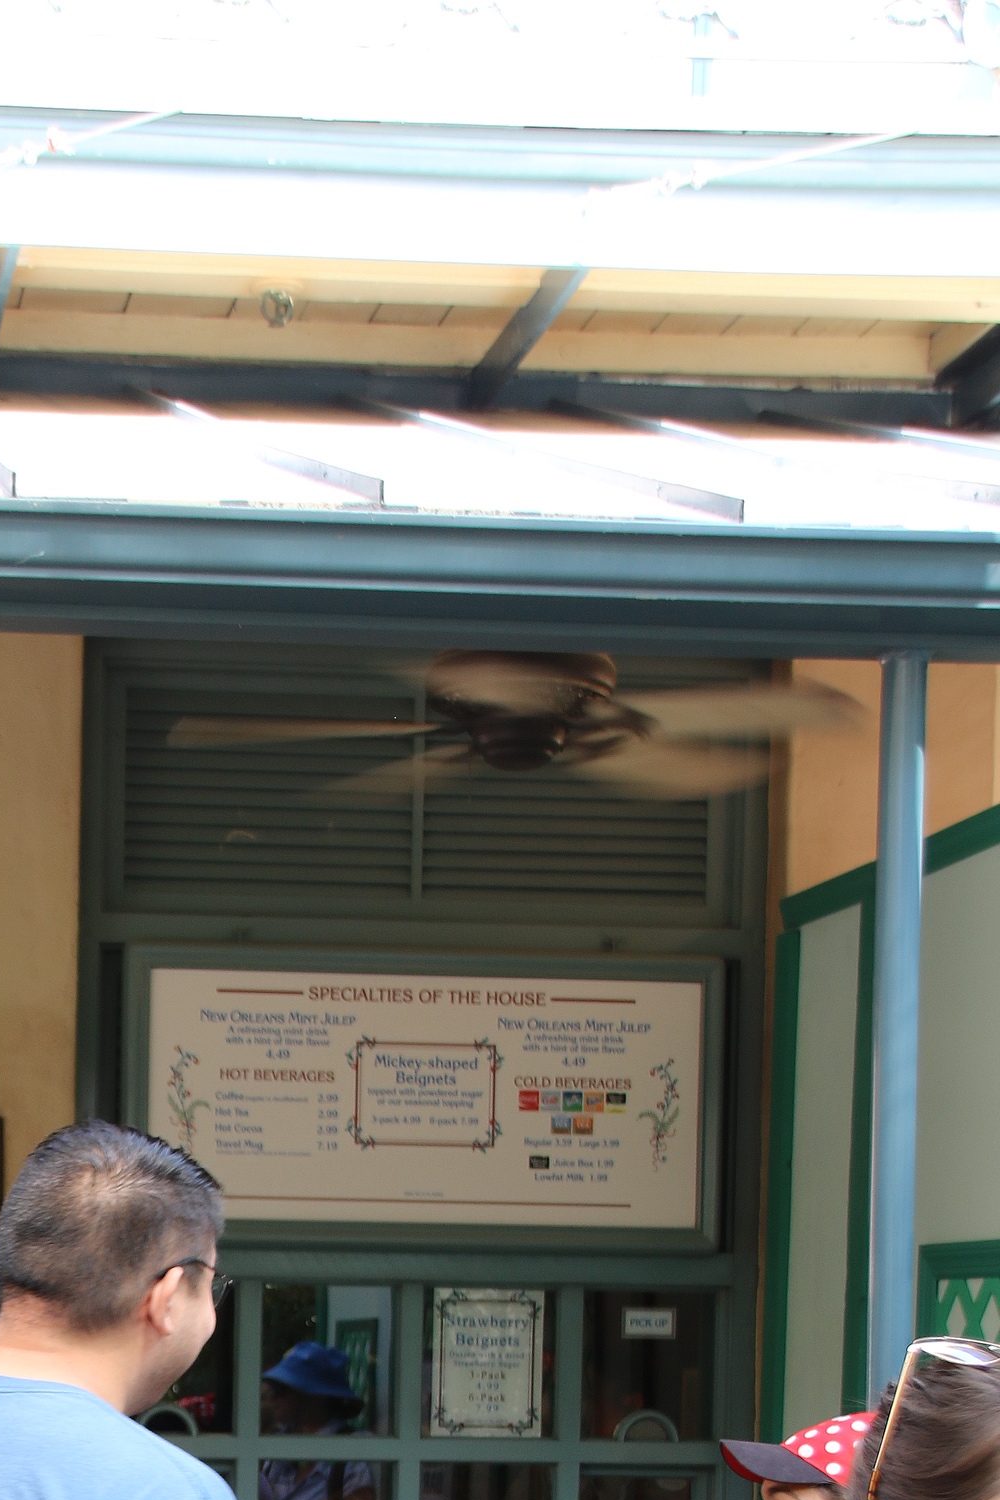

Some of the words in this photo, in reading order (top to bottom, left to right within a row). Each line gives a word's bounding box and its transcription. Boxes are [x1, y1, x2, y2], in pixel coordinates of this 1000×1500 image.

[308, 986, 413, 1004] SPECIALTIES
[418, 989, 442, 1004] OF
[449, 990, 481, 1005] THE
[486, 991, 547, 1006] HOUSE
[375, 1054, 478, 1072] Mickey-shaped
[562, 1057, 586, 1067] 4.49
[220, 1068, 250, 1081] HOT
[254, 1069, 335, 1082] BEVERAGES
[395, 1069, 456, 1087] Beignets
[514, 1075, 552, 1088] COLD
[555, 1077, 632, 1090] BEVERAGES
[447, 1314, 529, 1331] Strawberry
[456, 1333, 520, 1348] Beignets
